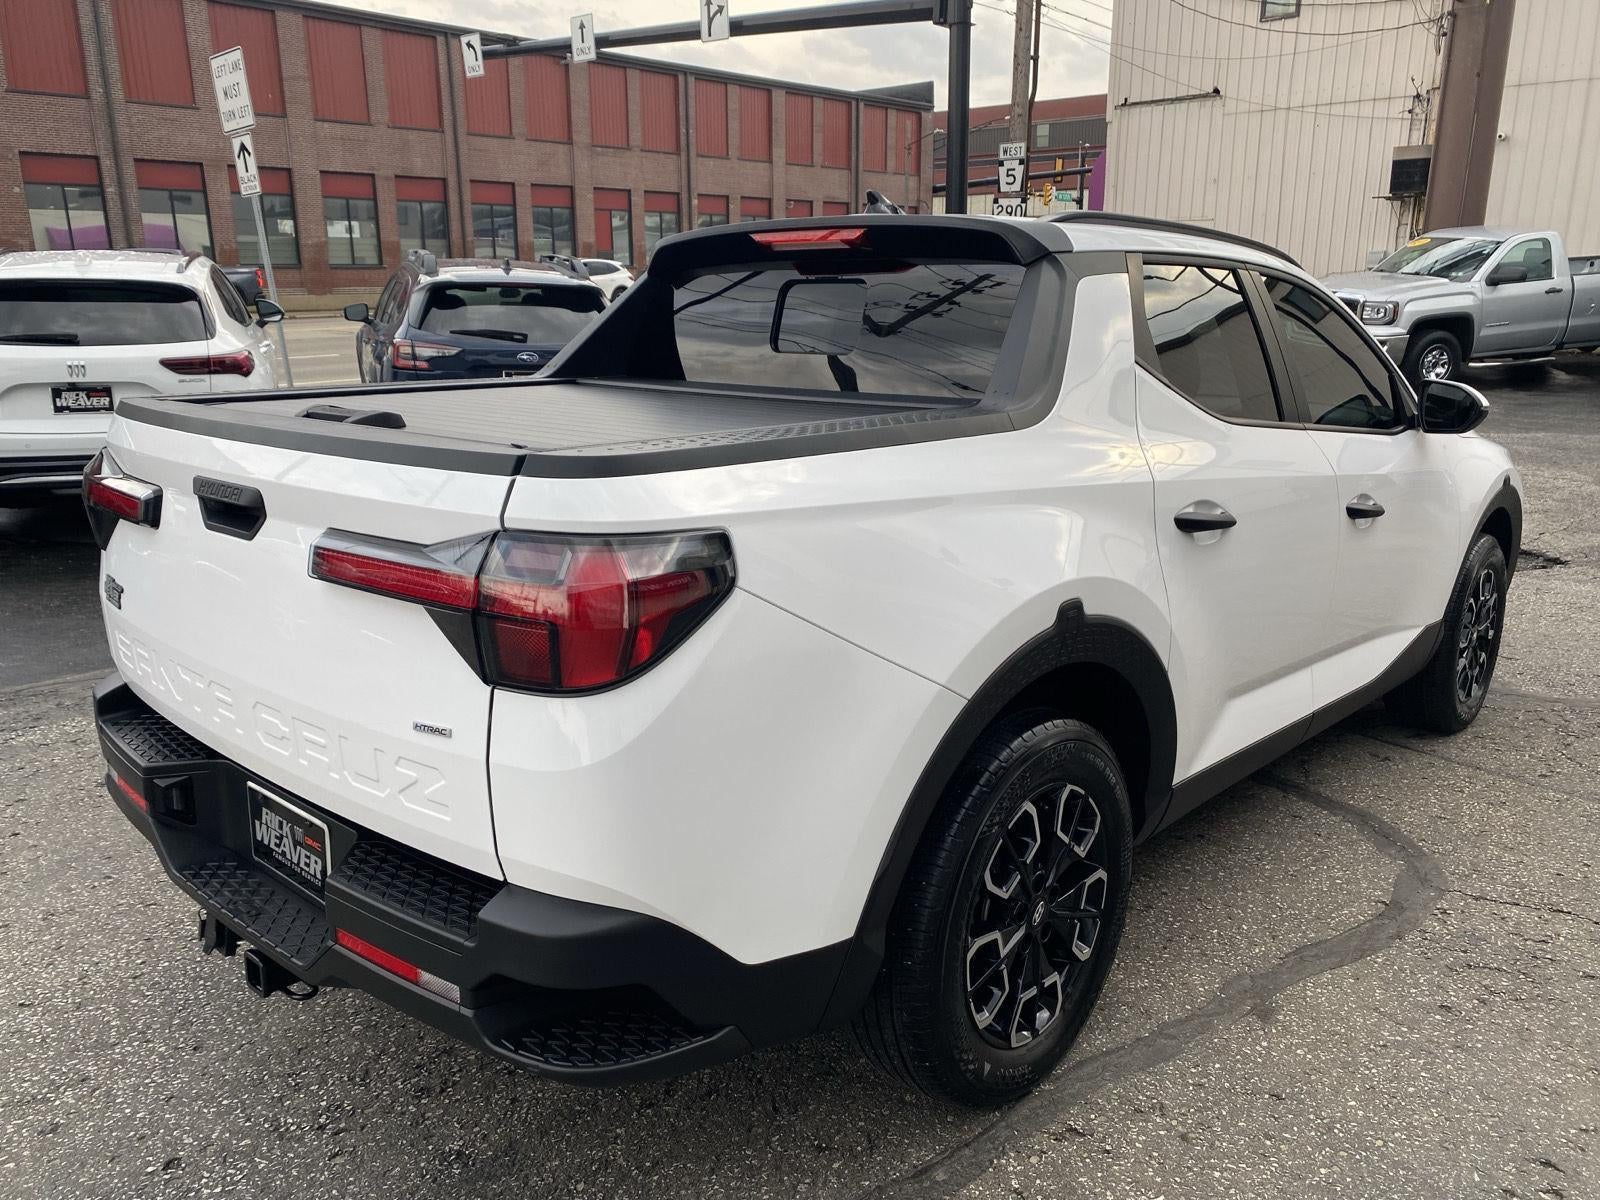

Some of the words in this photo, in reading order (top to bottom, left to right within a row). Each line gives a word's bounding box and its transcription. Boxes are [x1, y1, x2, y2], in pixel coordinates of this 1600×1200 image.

[576, 46, 592, 57] ONLY
[213, 63, 227, 79] LEFT
[228, 59, 243, 74] LANE
[467, 64, 481, 75] ONLY
[222, 82, 241, 101] MUST
[222, 109, 237, 123] TURN
[237, 105, 250, 118] LEFT
[1002, 146, 1023, 157] WEST
[240, 174, 256, 184] BLACK
[1005, 168, 1017, 186] 5
[996, 203, 1024, 218] 290
[55, 397, 110, 407] WEAVER
[61, 391, 86, 400] RICK
[198, 479, 243, 503] HYUNDAI
[114, 630, 244, 735] SANTA
[252, 701, 452, 822] CRUZ
[414, 723, 448, 736] HTRAC
[262, 806, 292, 837] RICK
[304, 836, 322, 852] GMC
[254, 819, 322, 880] WEAVER
